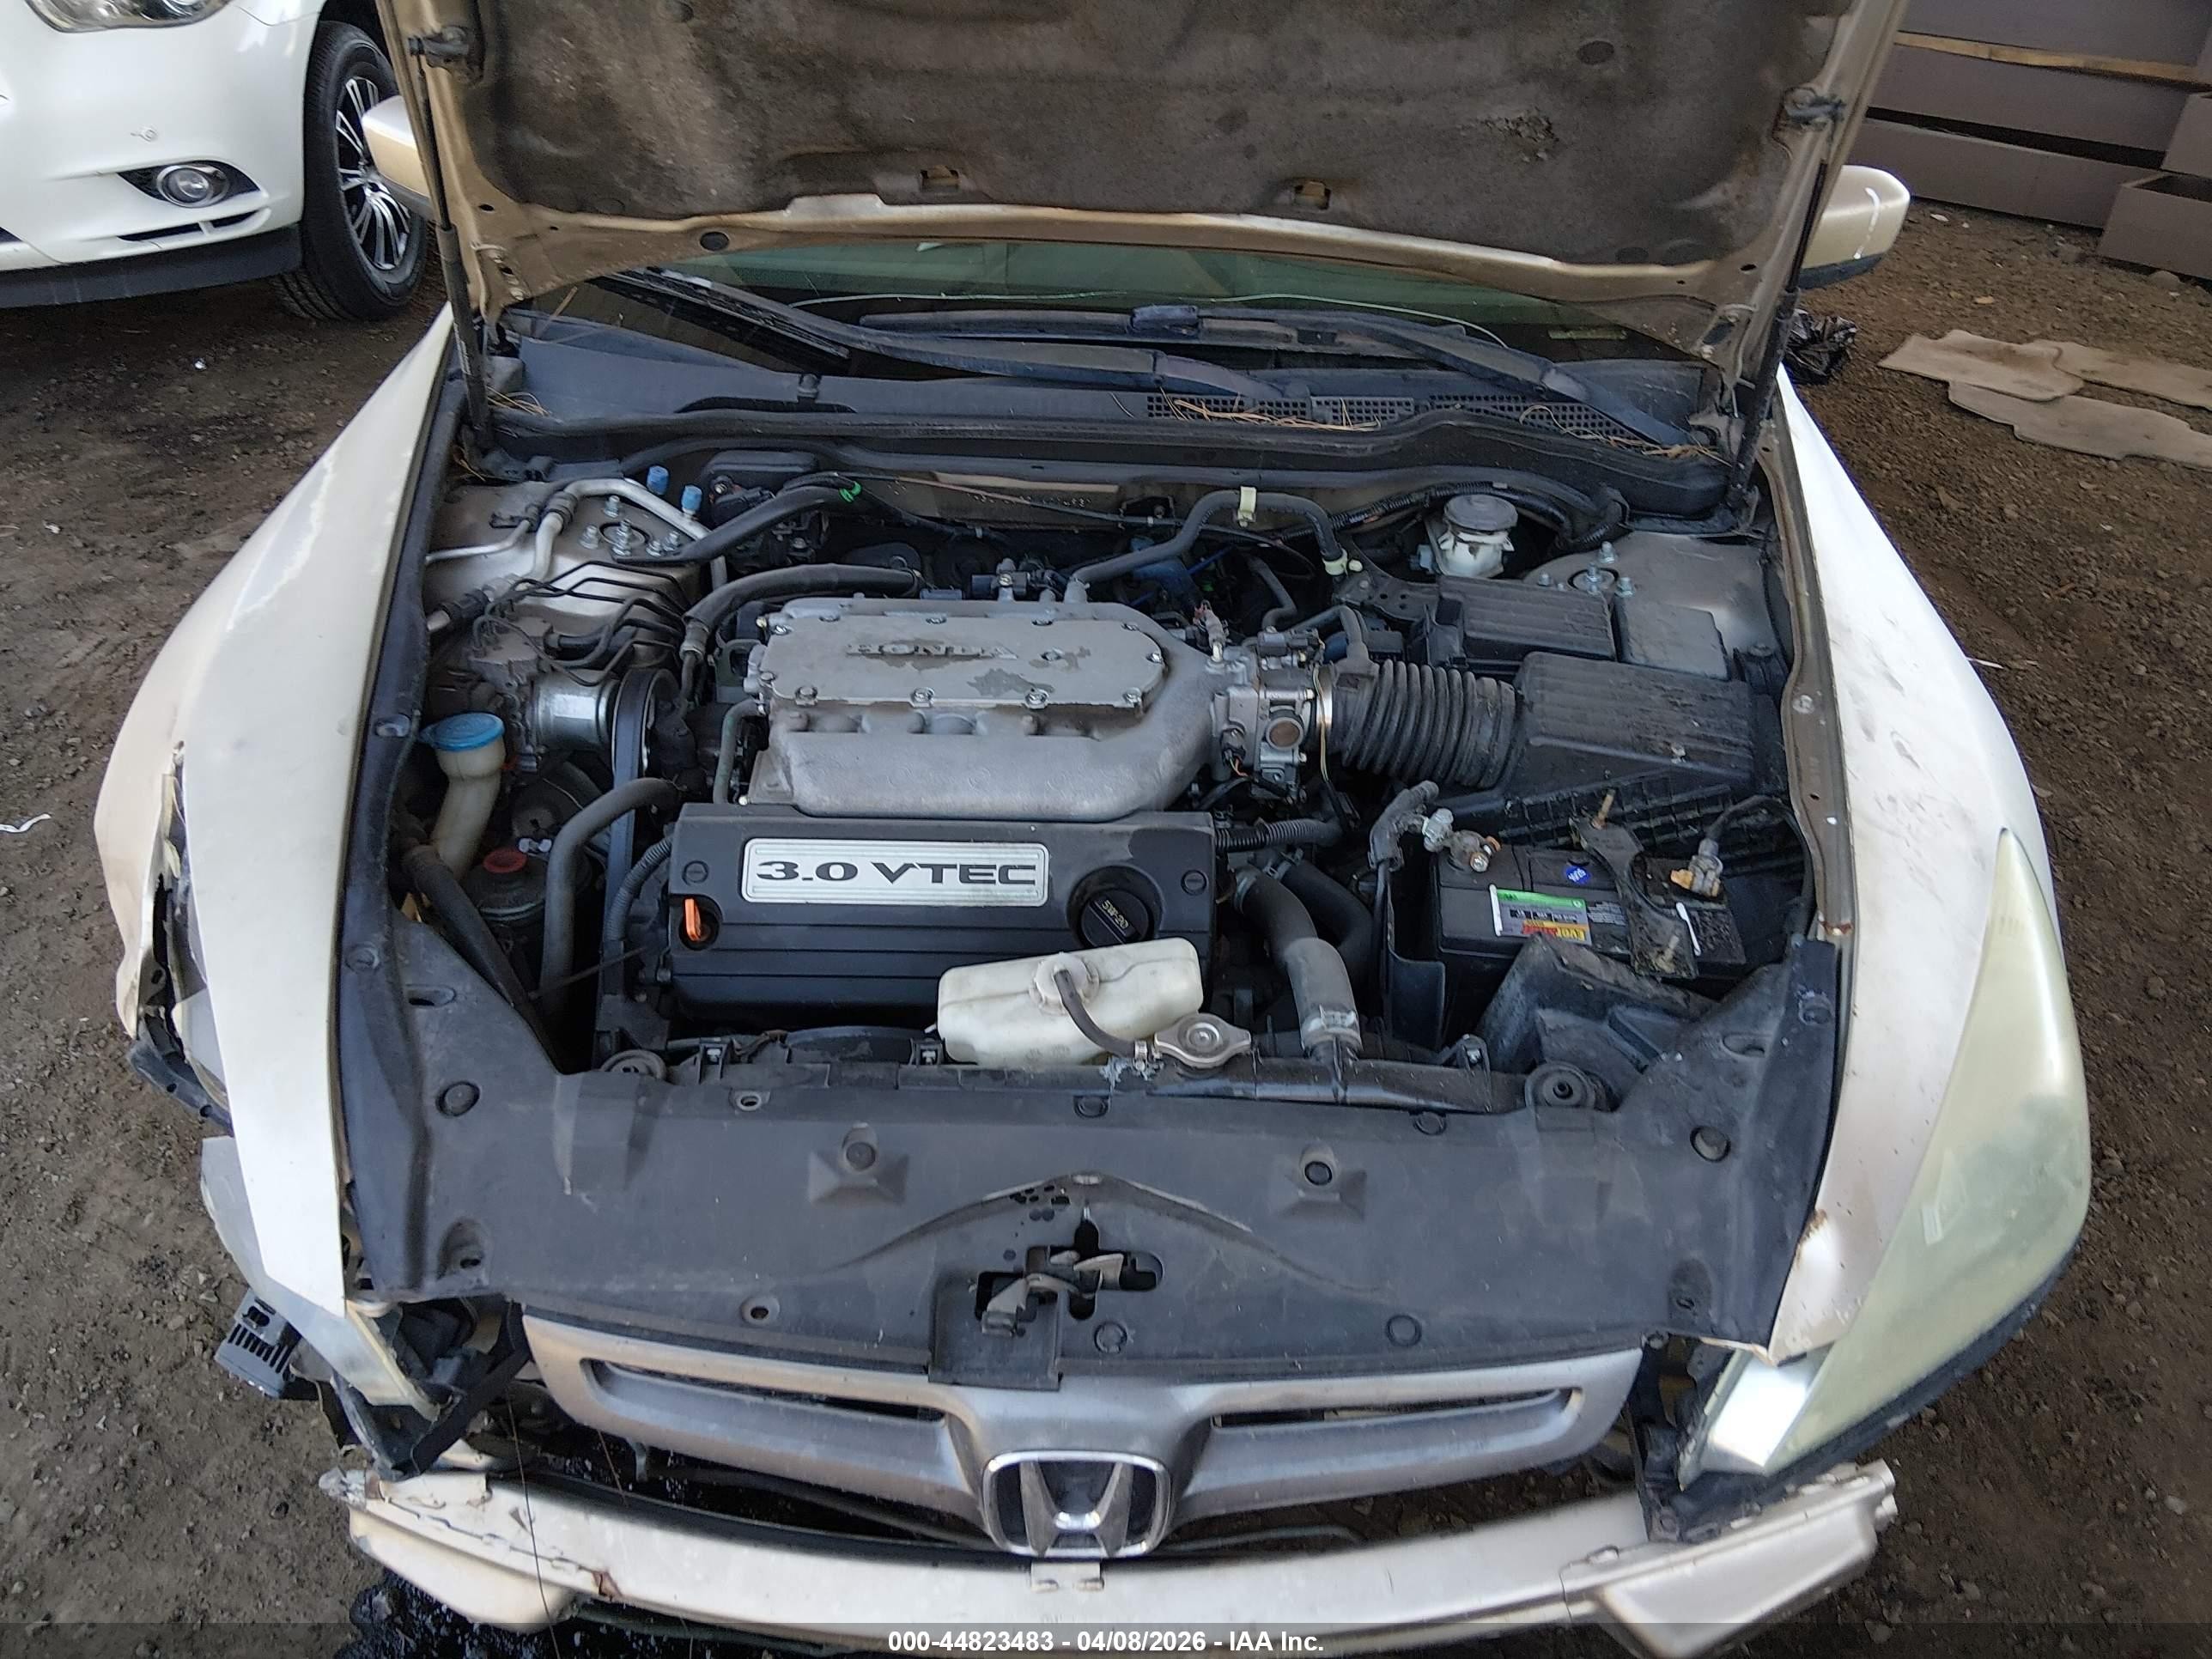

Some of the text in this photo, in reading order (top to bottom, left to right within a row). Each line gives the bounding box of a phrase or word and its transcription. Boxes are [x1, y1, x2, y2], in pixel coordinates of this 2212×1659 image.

[846, 643, 1019, 659] HONDA
[756, 860, 1036, 885] 3.0 VTEC
